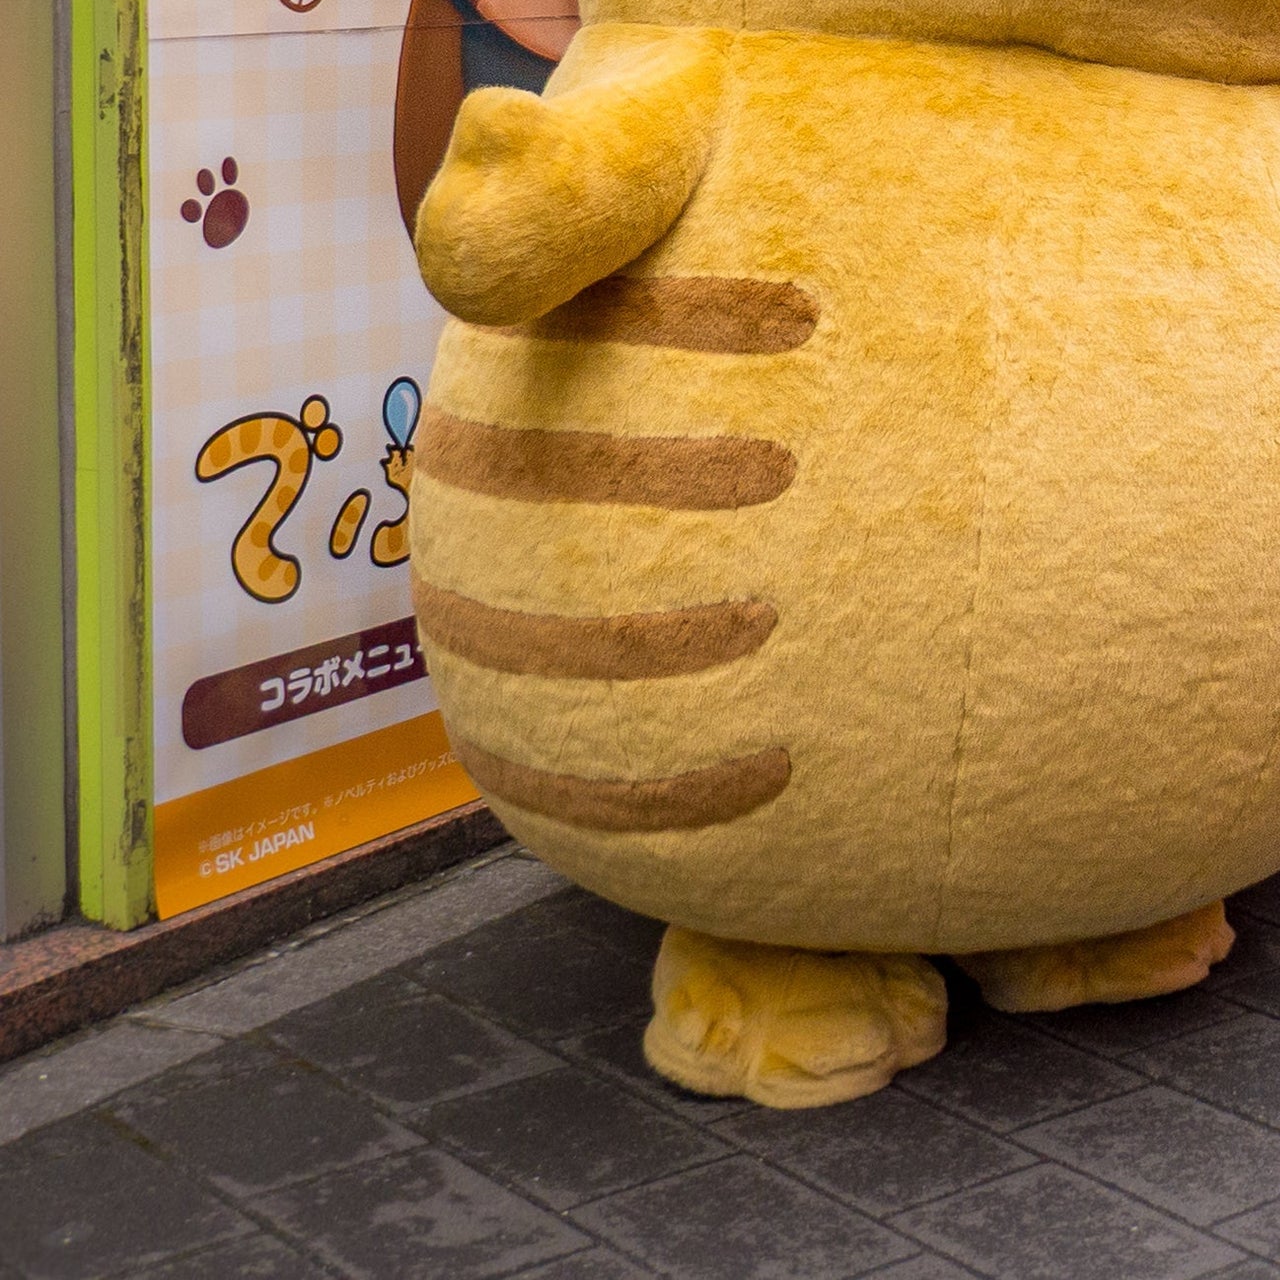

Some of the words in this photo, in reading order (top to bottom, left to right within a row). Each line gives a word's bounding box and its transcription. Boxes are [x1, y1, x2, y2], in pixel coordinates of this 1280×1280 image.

[260, 644, 424, 712] コラボメニュ
[249, 821, 316, 862] JAPAN
